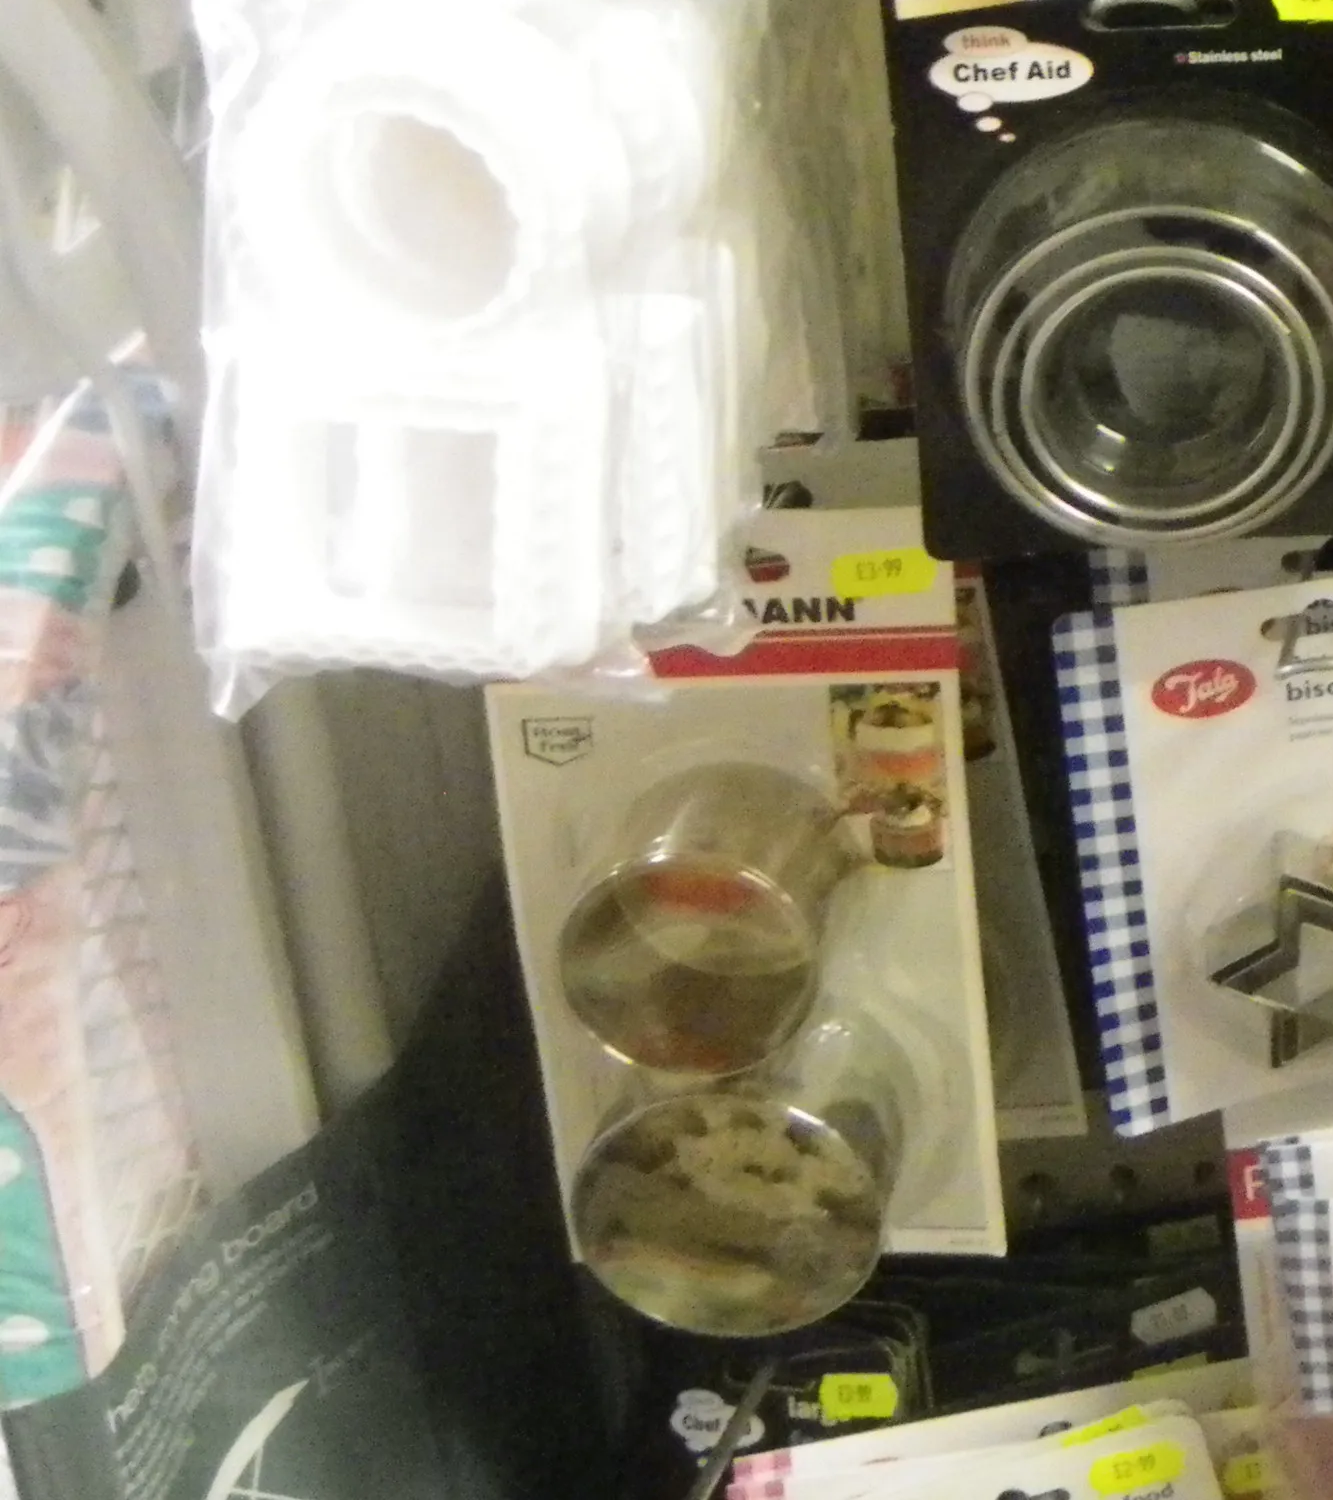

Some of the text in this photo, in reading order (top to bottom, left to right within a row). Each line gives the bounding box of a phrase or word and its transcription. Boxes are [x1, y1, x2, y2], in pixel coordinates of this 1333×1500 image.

[961, 34, 1010, 49] think
[1188, 48, 1283, 64] Stainless steel
[953, 60, 1072, 83] Chef Aid
